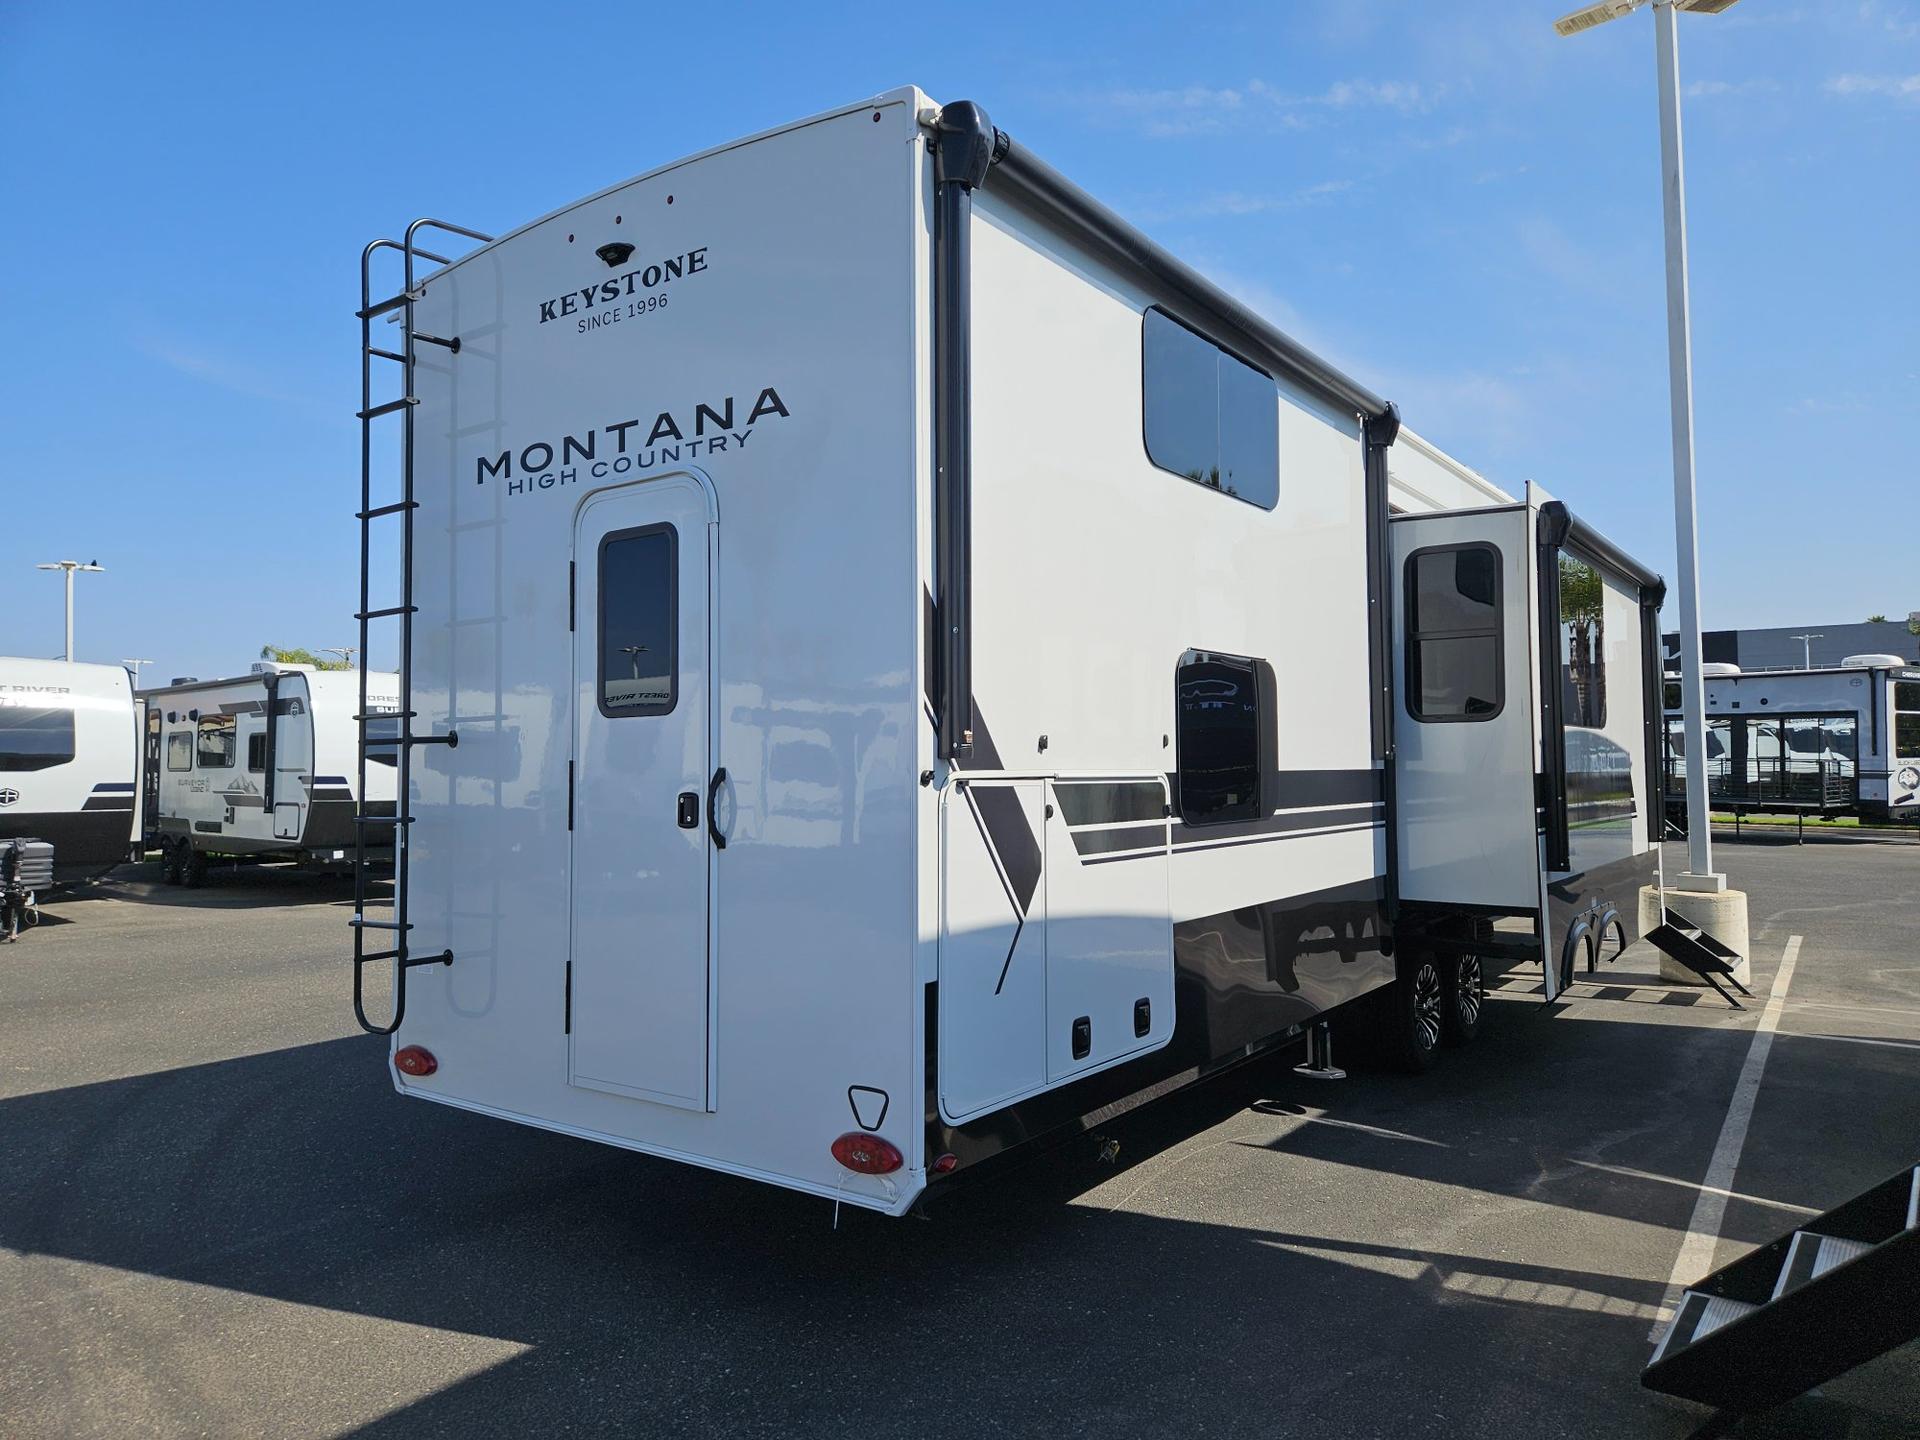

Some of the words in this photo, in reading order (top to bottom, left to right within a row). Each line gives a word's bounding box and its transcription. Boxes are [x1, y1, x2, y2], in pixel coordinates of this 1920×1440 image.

[539, 247, 708, 324] KEYSTONE
[578, 307, 621, 334] SINCE
[627, 293, 669, 319] 1996
[477, 387, 790, 485] MONTANA
[508, 467, 577, 496] HIGH
[591, 429, 753, 478] COUNTRY
